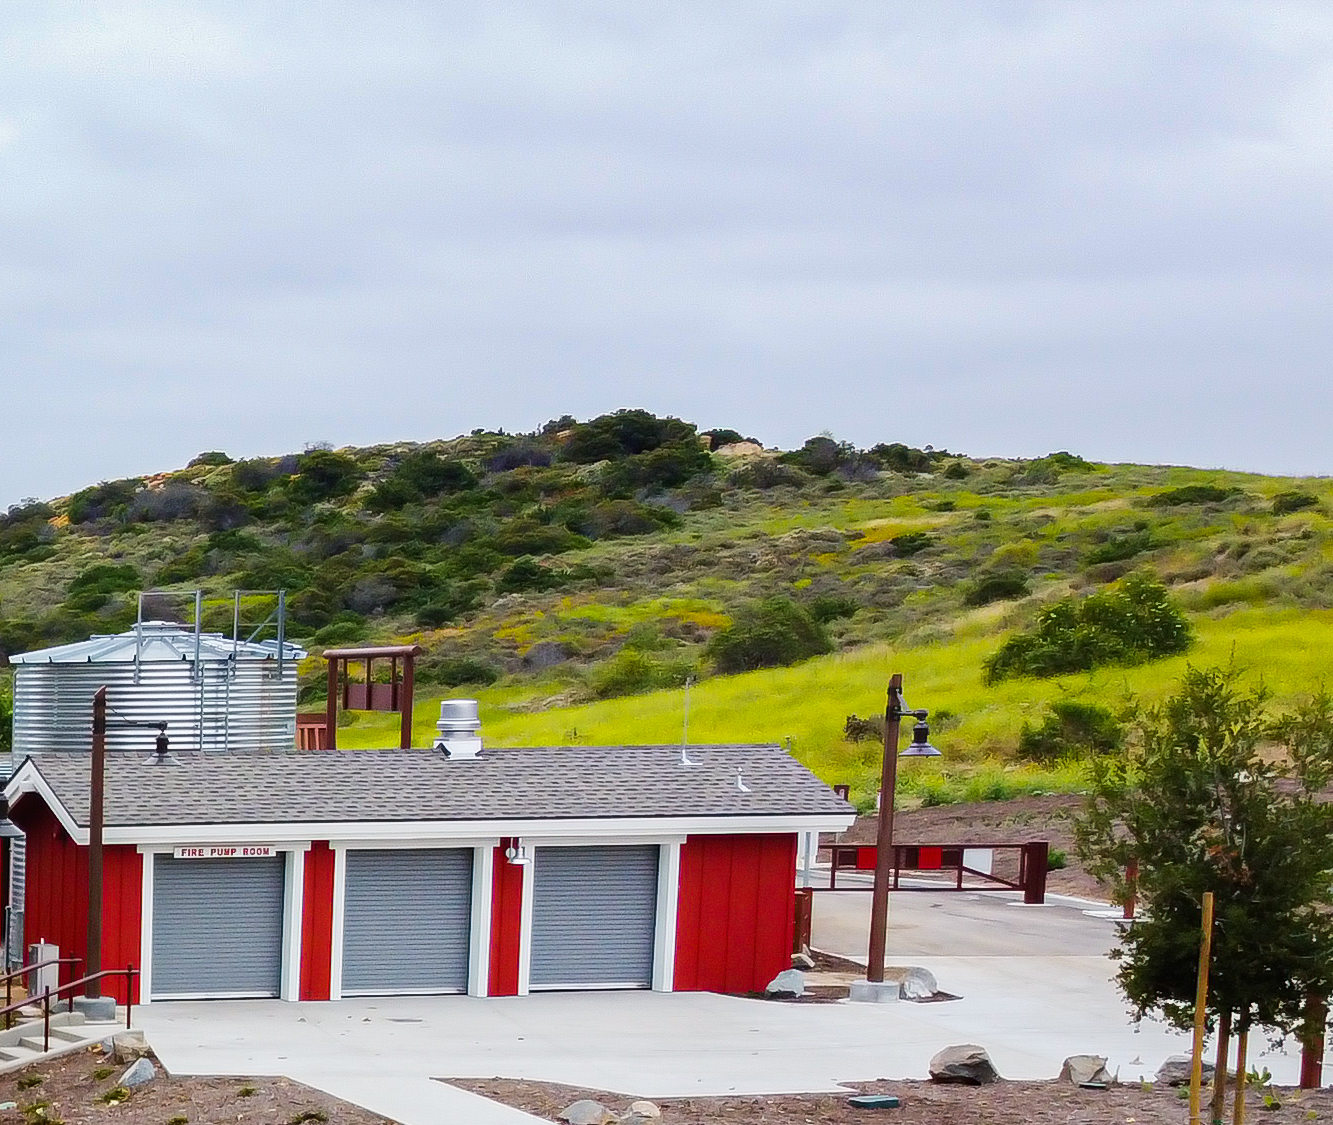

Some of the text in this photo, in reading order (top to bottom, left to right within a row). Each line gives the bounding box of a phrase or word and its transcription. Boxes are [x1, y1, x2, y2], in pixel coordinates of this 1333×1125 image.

[181, 847, 270, 857] FIRE PUMP ROOM
